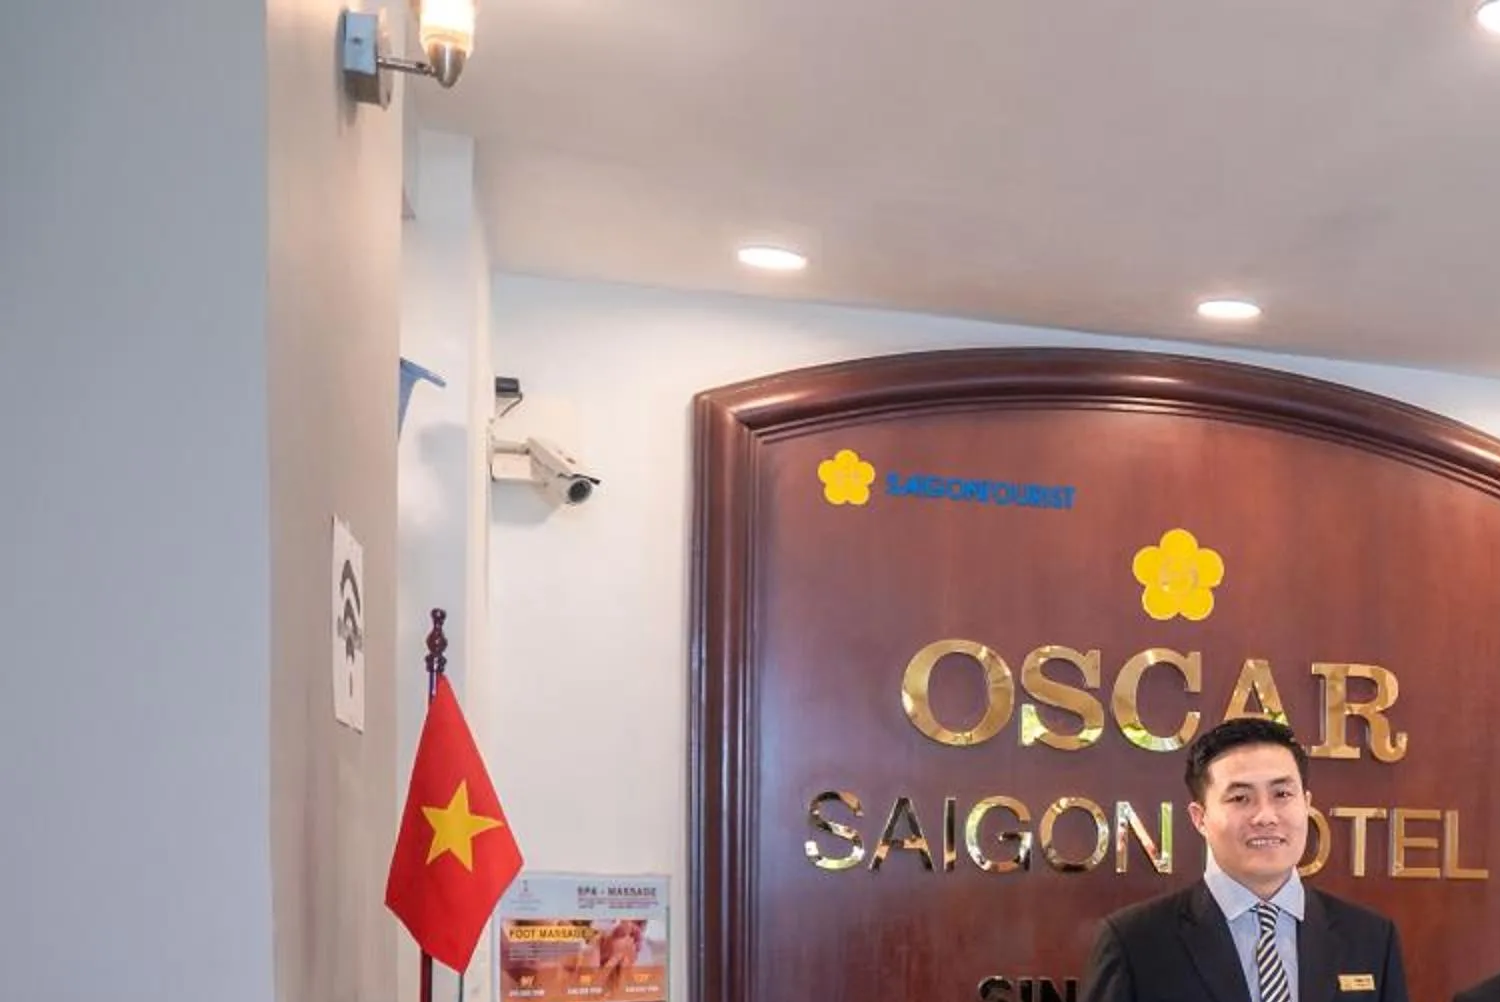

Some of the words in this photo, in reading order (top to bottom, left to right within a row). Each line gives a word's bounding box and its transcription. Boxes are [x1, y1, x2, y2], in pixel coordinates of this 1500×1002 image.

[885, 471, 1077, 510] SAIGONTOURIST
[901, 638, 1408, 764] OSCAR
[804, 790, 1173, 875] SAIGON
[608, 886, 657, 897] MASSAGE
[509, 928, 536, 939] FOOT
[539, 928, 586, 939] MASSAGE
